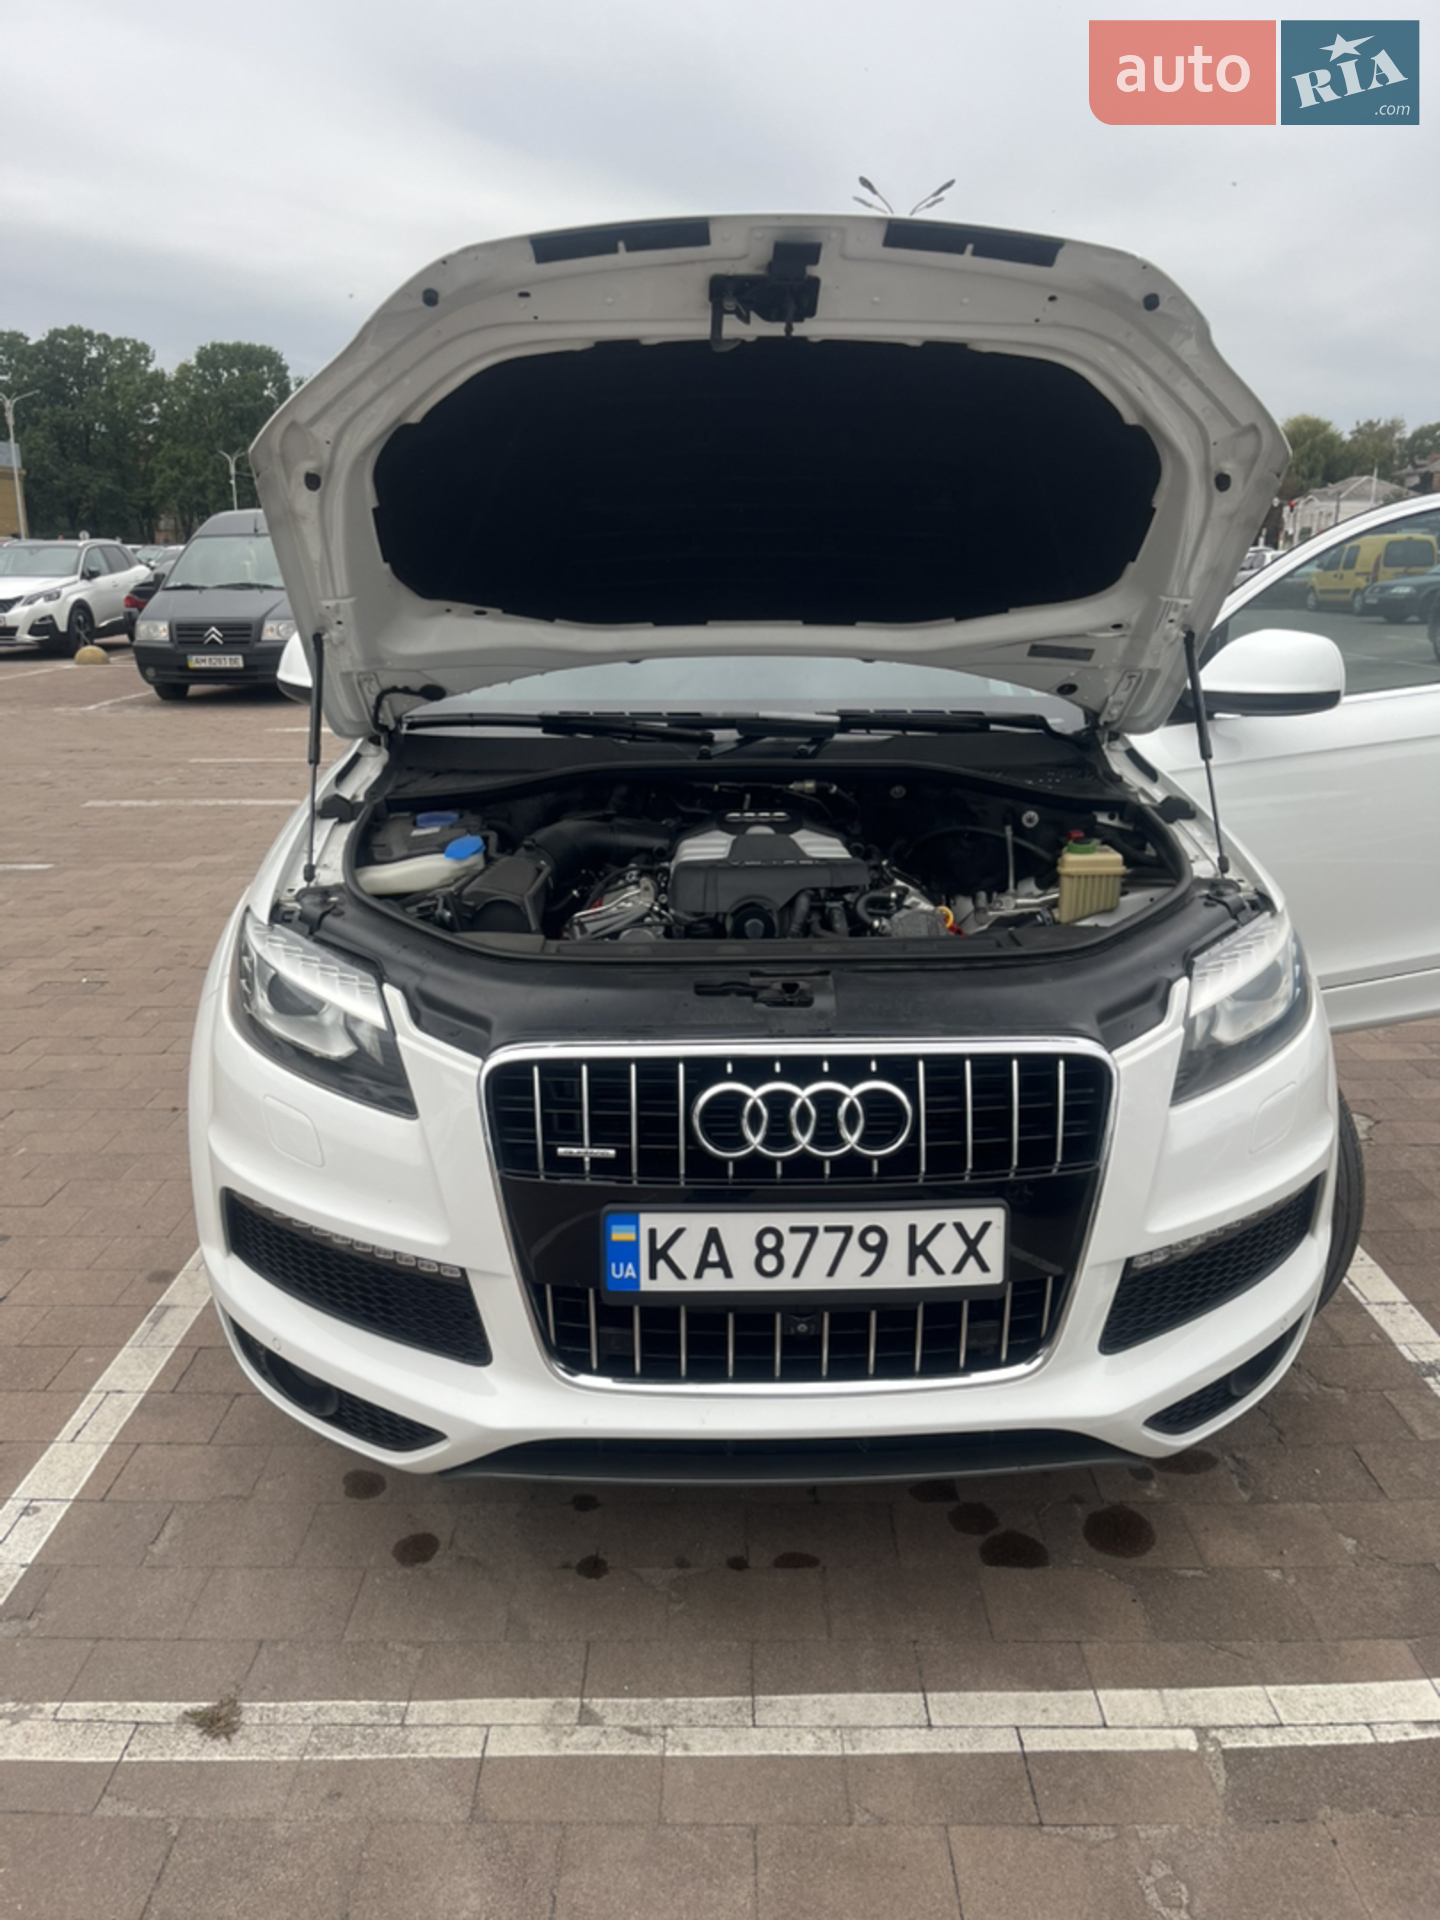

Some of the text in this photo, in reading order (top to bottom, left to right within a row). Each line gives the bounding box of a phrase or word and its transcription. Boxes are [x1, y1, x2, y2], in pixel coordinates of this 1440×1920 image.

[647, 1220, 993, 1281] KA 8779 KX
[610, 1262, 637, 1279] UA
